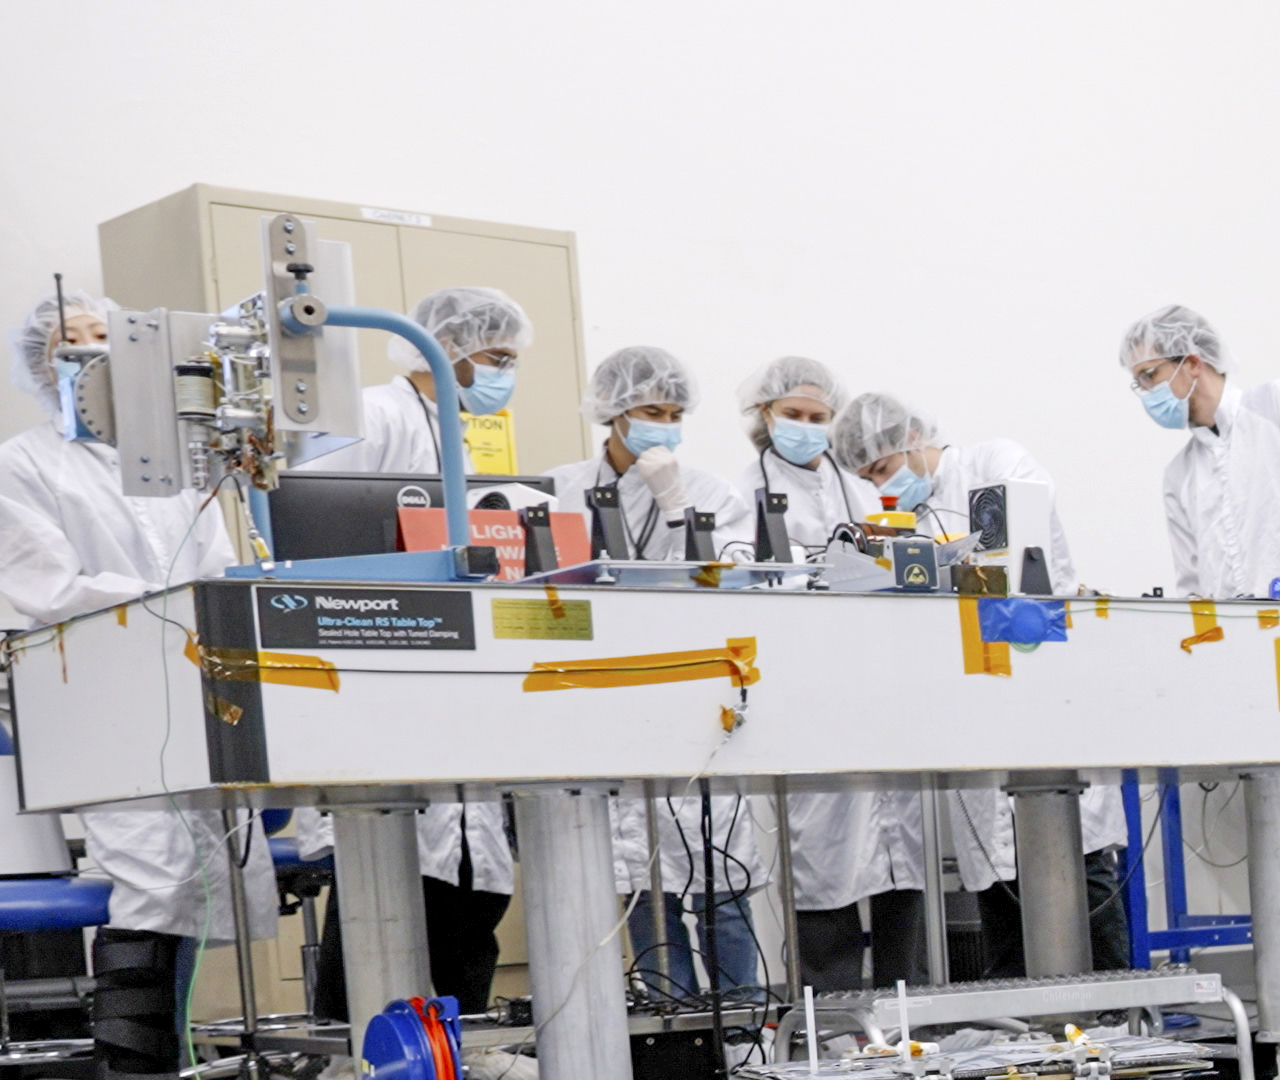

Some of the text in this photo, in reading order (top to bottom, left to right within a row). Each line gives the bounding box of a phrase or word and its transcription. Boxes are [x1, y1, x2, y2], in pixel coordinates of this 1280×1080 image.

[402, 495, 426, 504] DELL
[471, 524, 523, 540] LIGH
[315, 595, 399, 612] Newport
[317, 617, 373, 627] Ultra-Clean
[375, 617, 390, 627] RS
[391, 617, 417, 628] Table
[318, 628, 343, 637] Sealed
[361, 629, 379, 638] Table
[380, 629, 392, 639] Top
[393, 629, 407, 638] with
